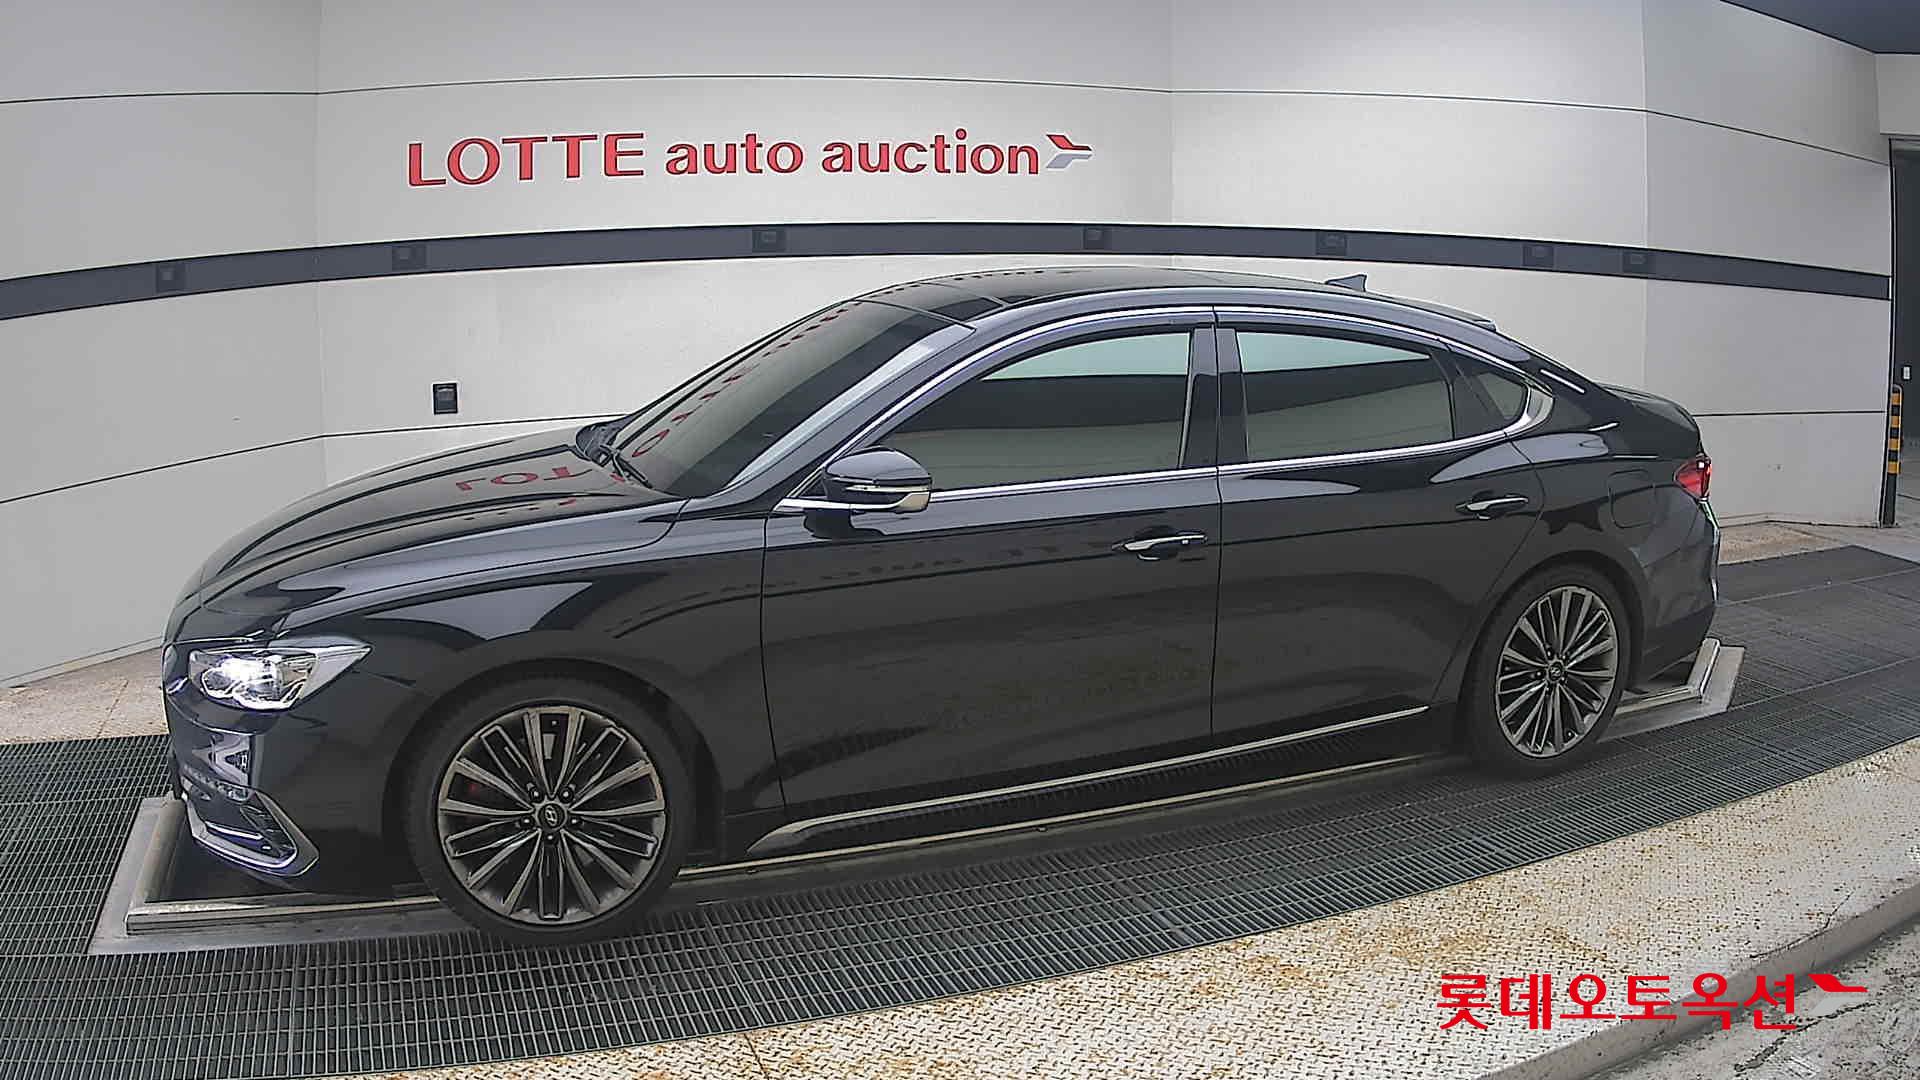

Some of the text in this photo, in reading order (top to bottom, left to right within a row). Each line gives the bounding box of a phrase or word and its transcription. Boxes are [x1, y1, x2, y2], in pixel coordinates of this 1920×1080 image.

[408, 128, 1040, 187] LOTTE auto auction
